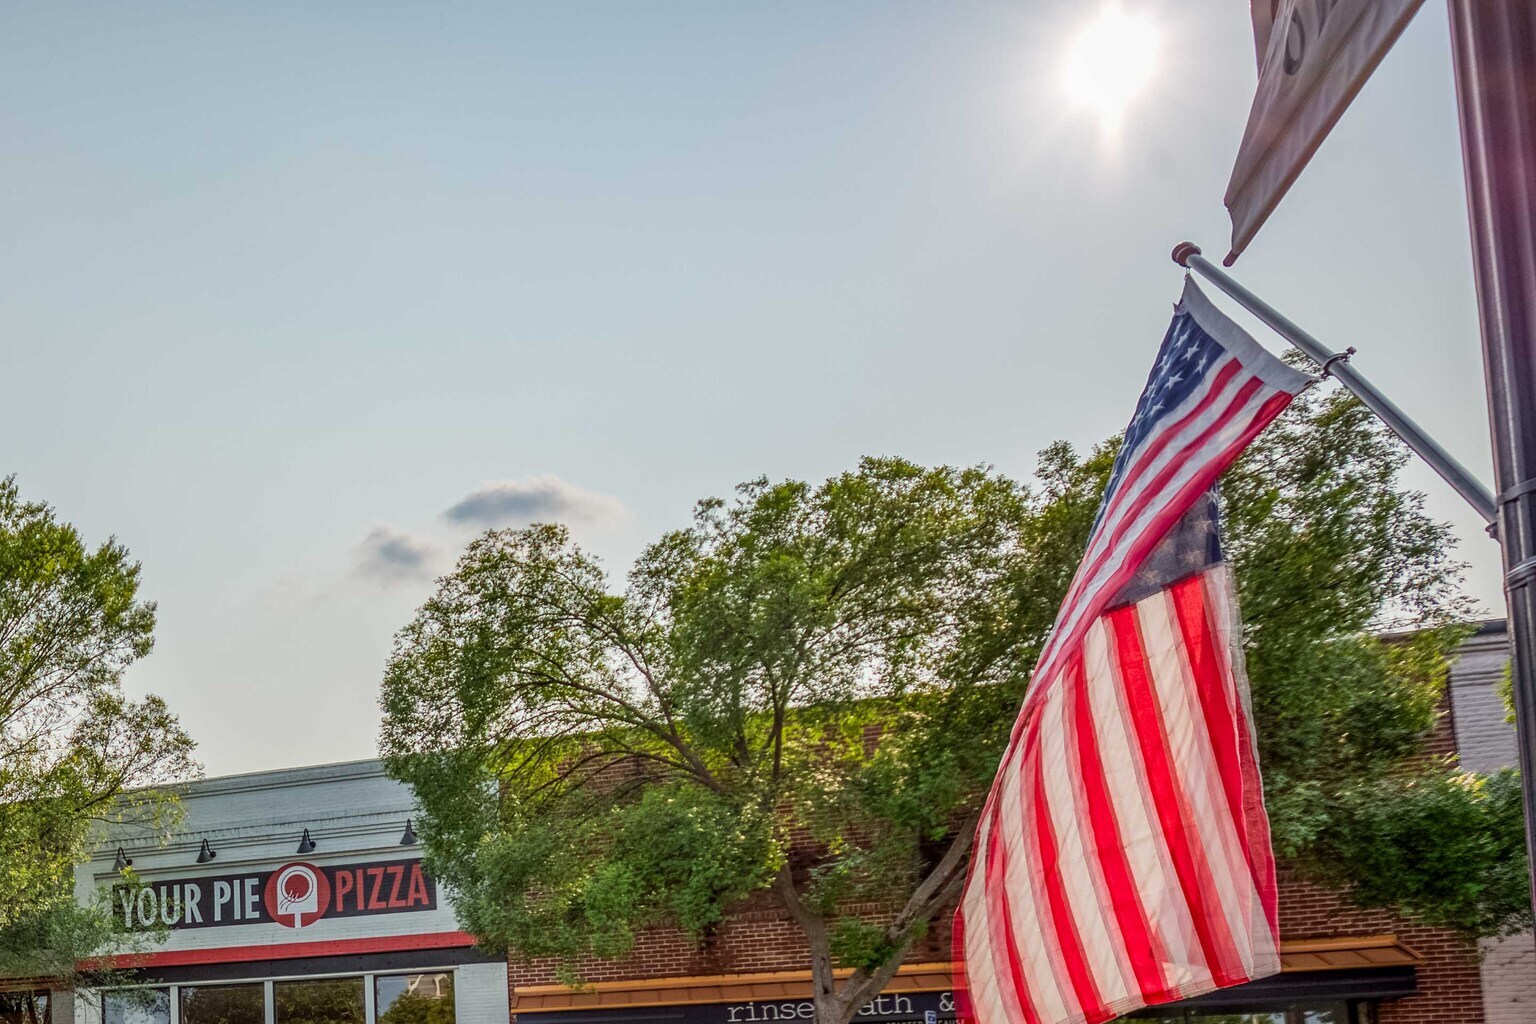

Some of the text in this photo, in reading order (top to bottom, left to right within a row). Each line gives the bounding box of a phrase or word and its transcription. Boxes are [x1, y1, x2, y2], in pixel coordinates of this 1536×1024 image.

[118, 863, 430, 928] YOUR PIE PIZZA
[727, 992, 955, 1023] rinse ath &
